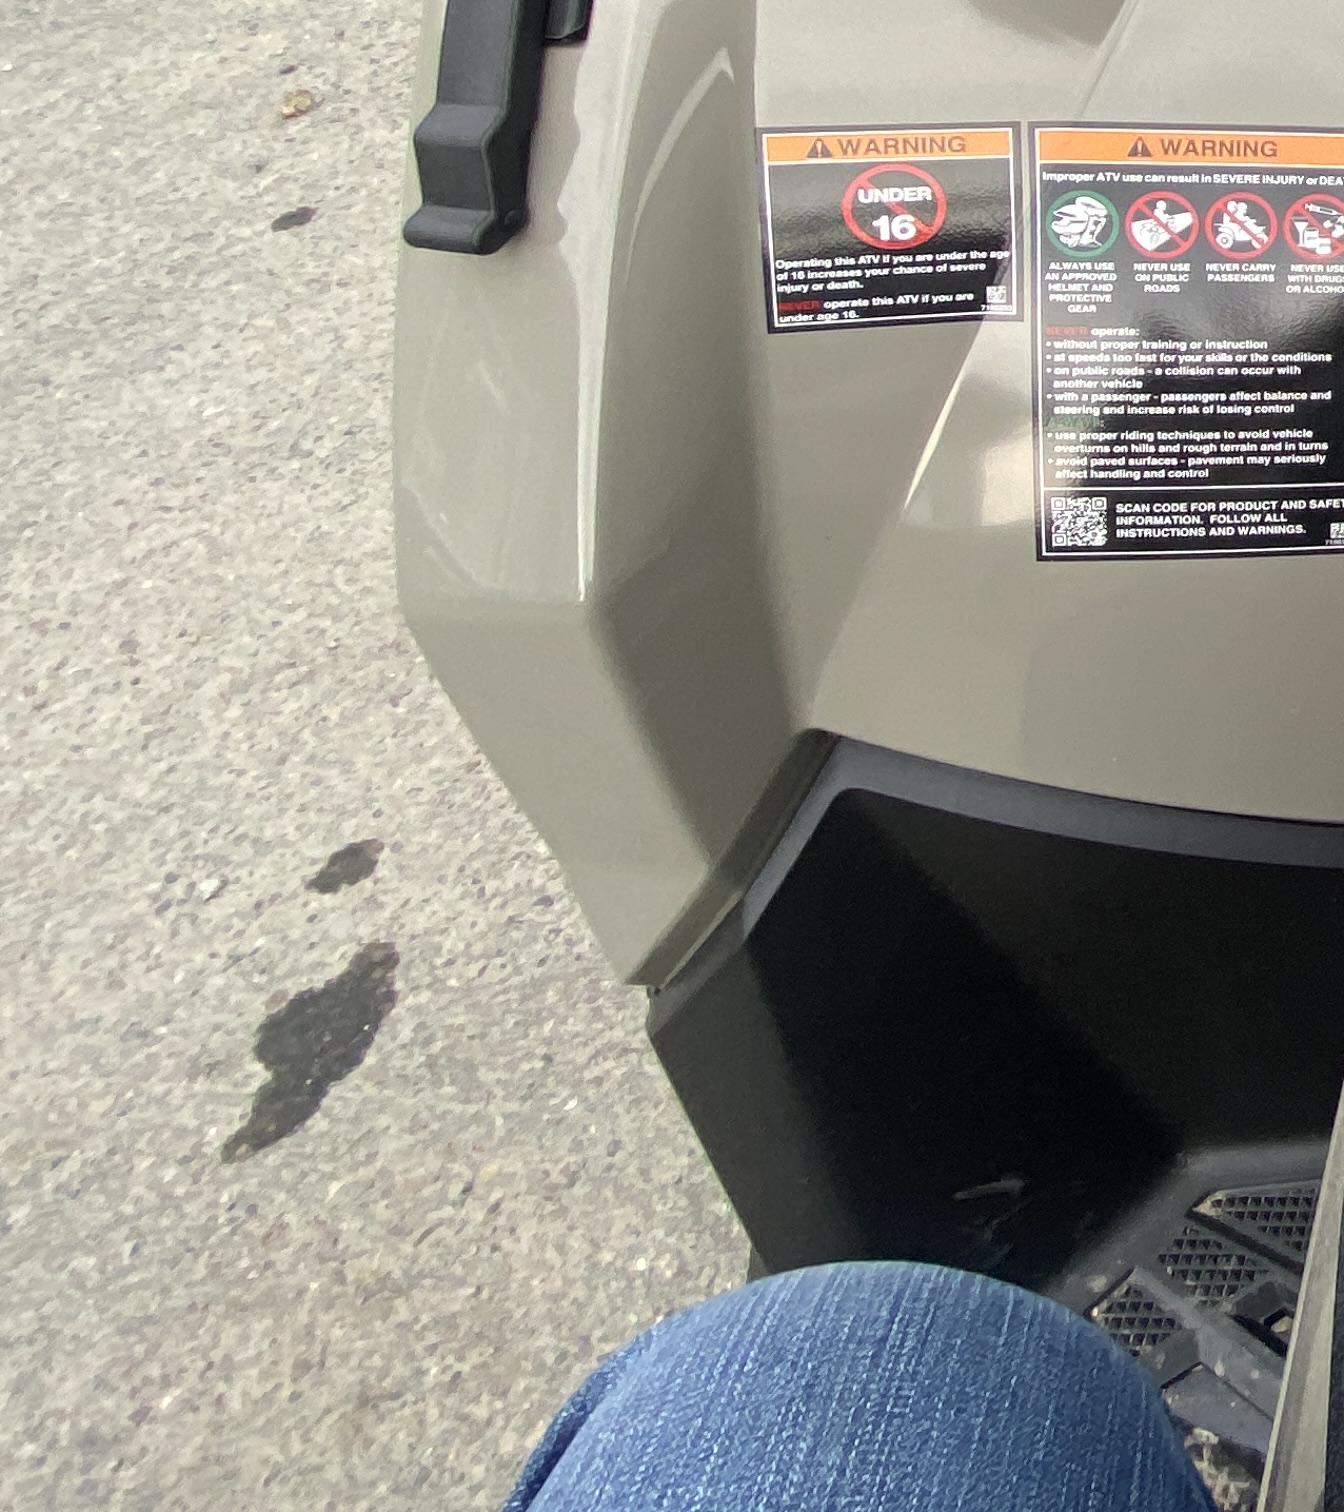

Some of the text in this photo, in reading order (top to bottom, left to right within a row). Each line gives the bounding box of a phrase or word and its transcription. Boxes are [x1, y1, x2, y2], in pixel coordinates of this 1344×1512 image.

[837, 136, 967, 156] WARNING
[1160, 138, 1278, 158] WARNING
[858, 186, 933, 204] UNDER
[872, 214, 916, 241] 16
[775, 258, 832, 270] Operating
[835, 256, 856, 266] this
[858, 255, 880, 265] ATV
[892, 254, 913, 265] you
[936, 251, 968, 261] under
[990, 250, 1010, 261] age
[776, 271, 789, 280] of
[807, 268, 863, 279] increases
[865, 267, 890, 279] your
[892, 264, 934, 274] chance
[936, 263, 948, 272] of
[950, 262, 987, 271] severe
[777, 282, 809, 295] injury
[812, 282, 825, 291] or
[1116, 503, 1150, 514] SCAN
[1153, 502, 1188, 513] CODE
[1190, 501, 1216, 512] FOR
[1219, 500, 1279, 512] PRODUCT
[1280, 499, 1306, 510] AND
[1116, 513, 1287, 525] INFORMATION. FOLLOW ALL
[1116, 524, 1307, 538] INSTRUCTIONS AND WARNINGS.
